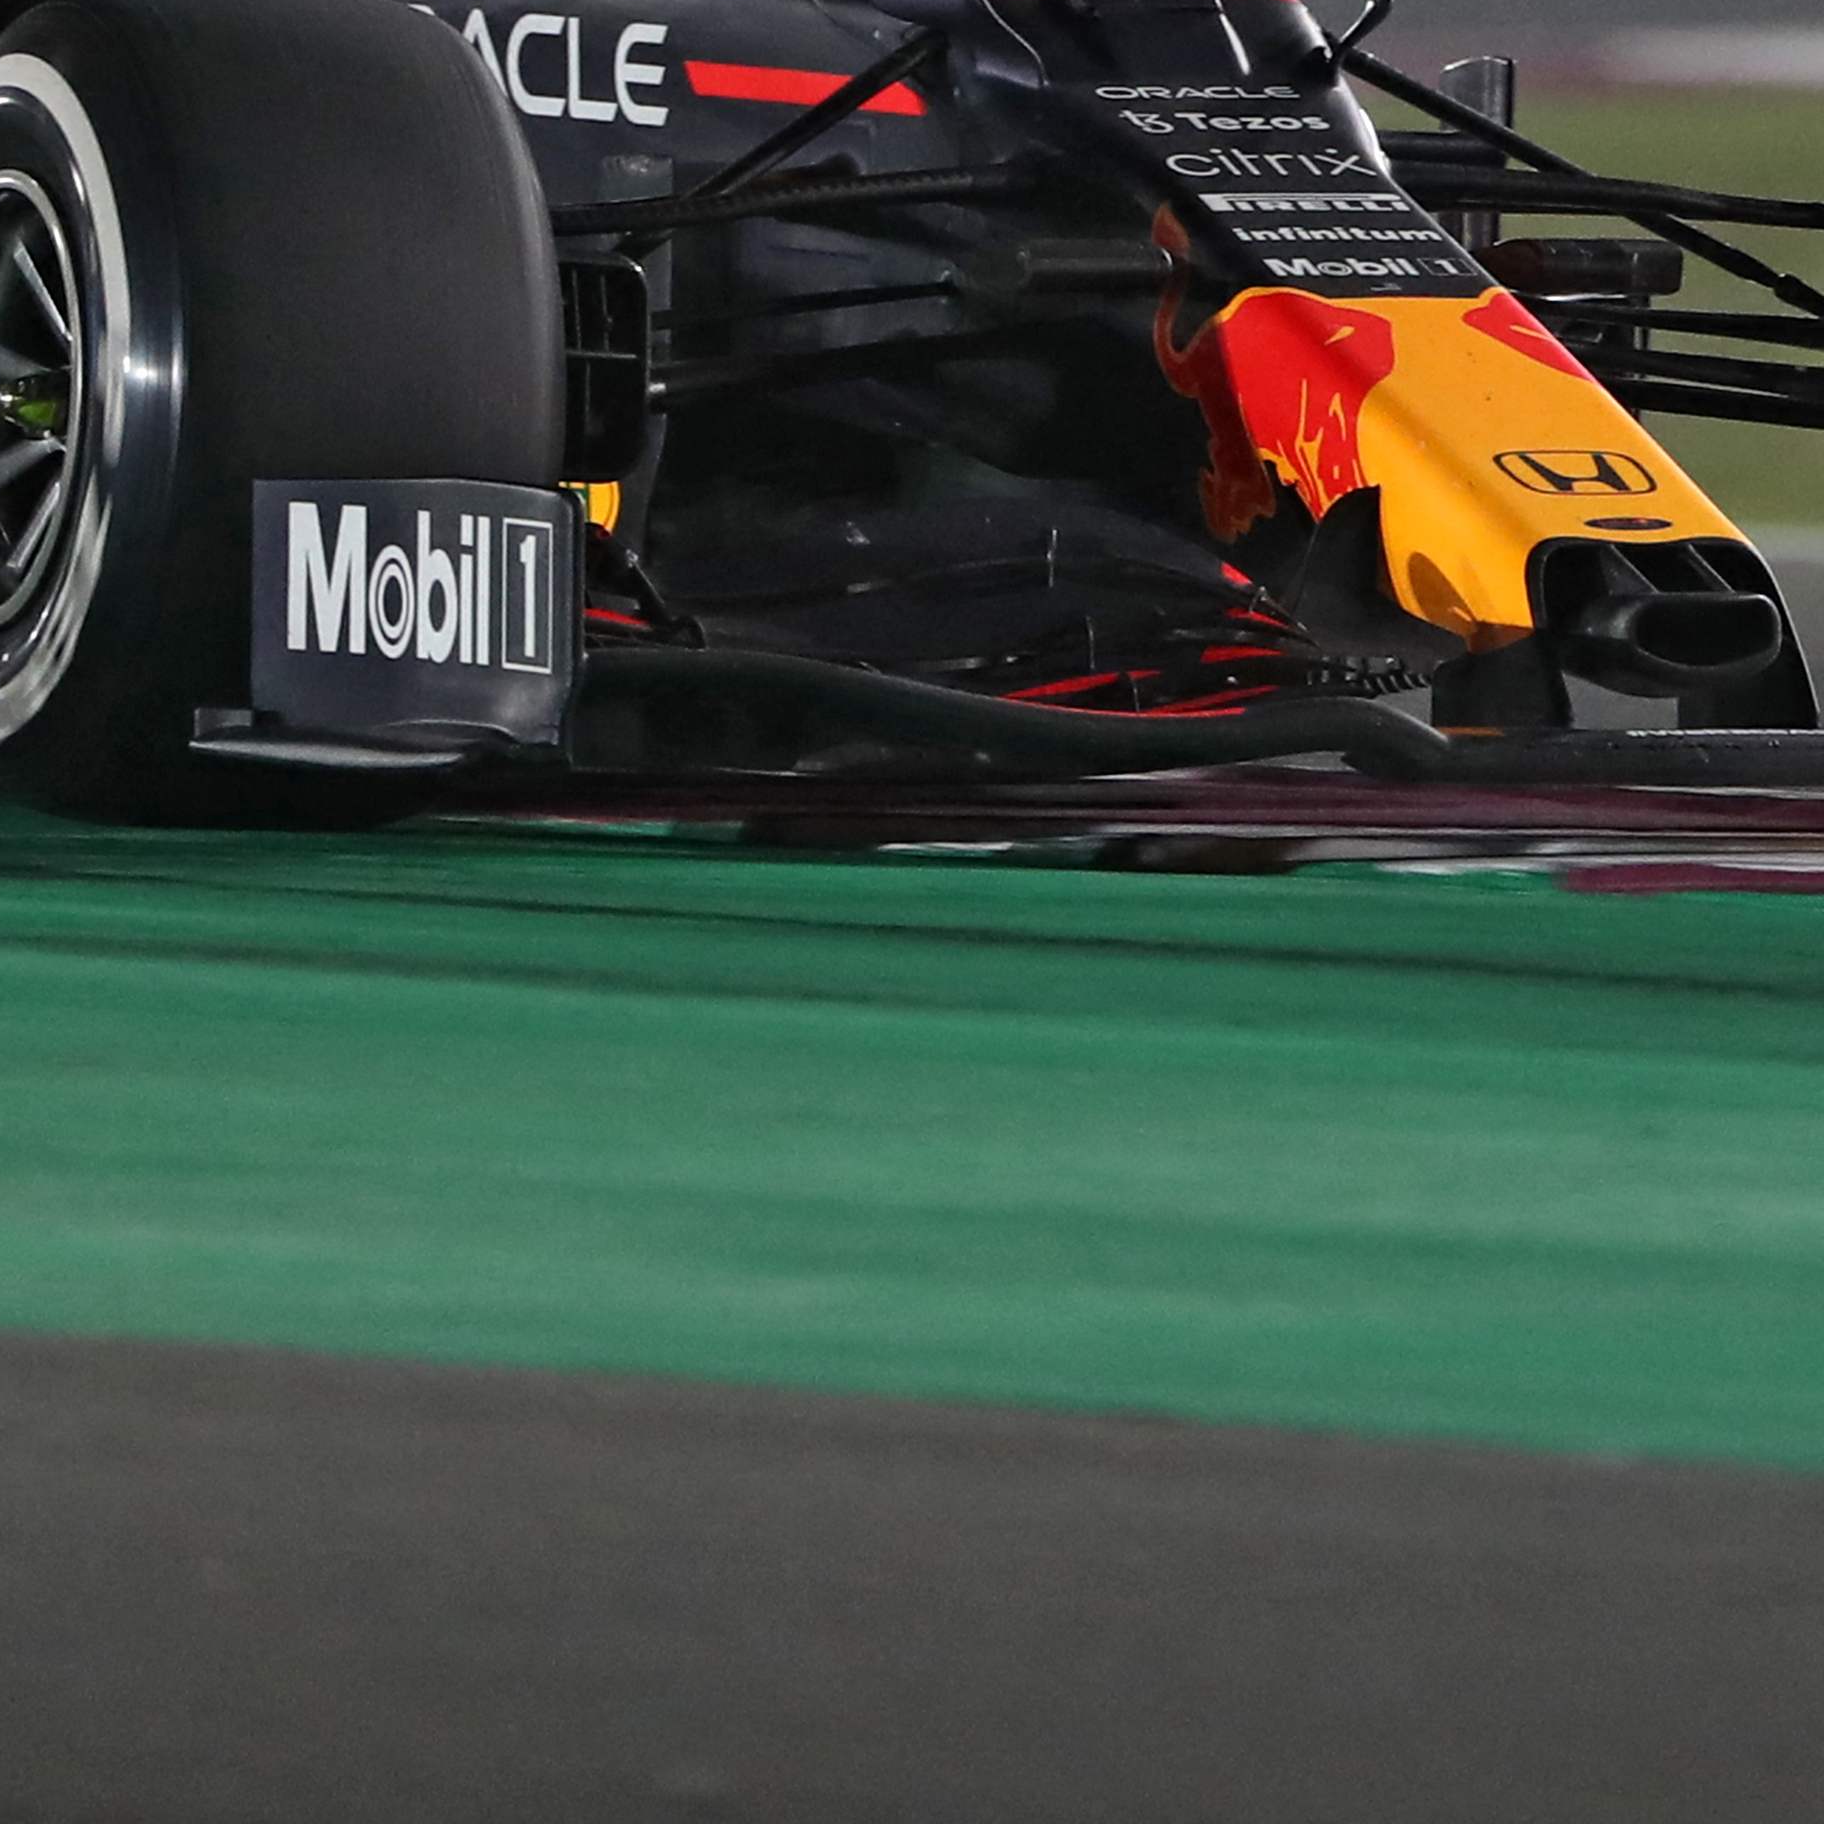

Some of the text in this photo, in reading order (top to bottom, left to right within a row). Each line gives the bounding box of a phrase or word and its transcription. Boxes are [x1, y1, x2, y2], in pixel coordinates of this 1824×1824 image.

[1095, 86, 1301, 99] ORACLE
[1174, 112, 1330, 130] Tezos
[1197, 192, 1411, 212] PIRELLI
[1232, 227, 1443, 242] infinitum
[1263, 257, 1420, 277] Mobil
[286, 500, 492, 666] Mobil
